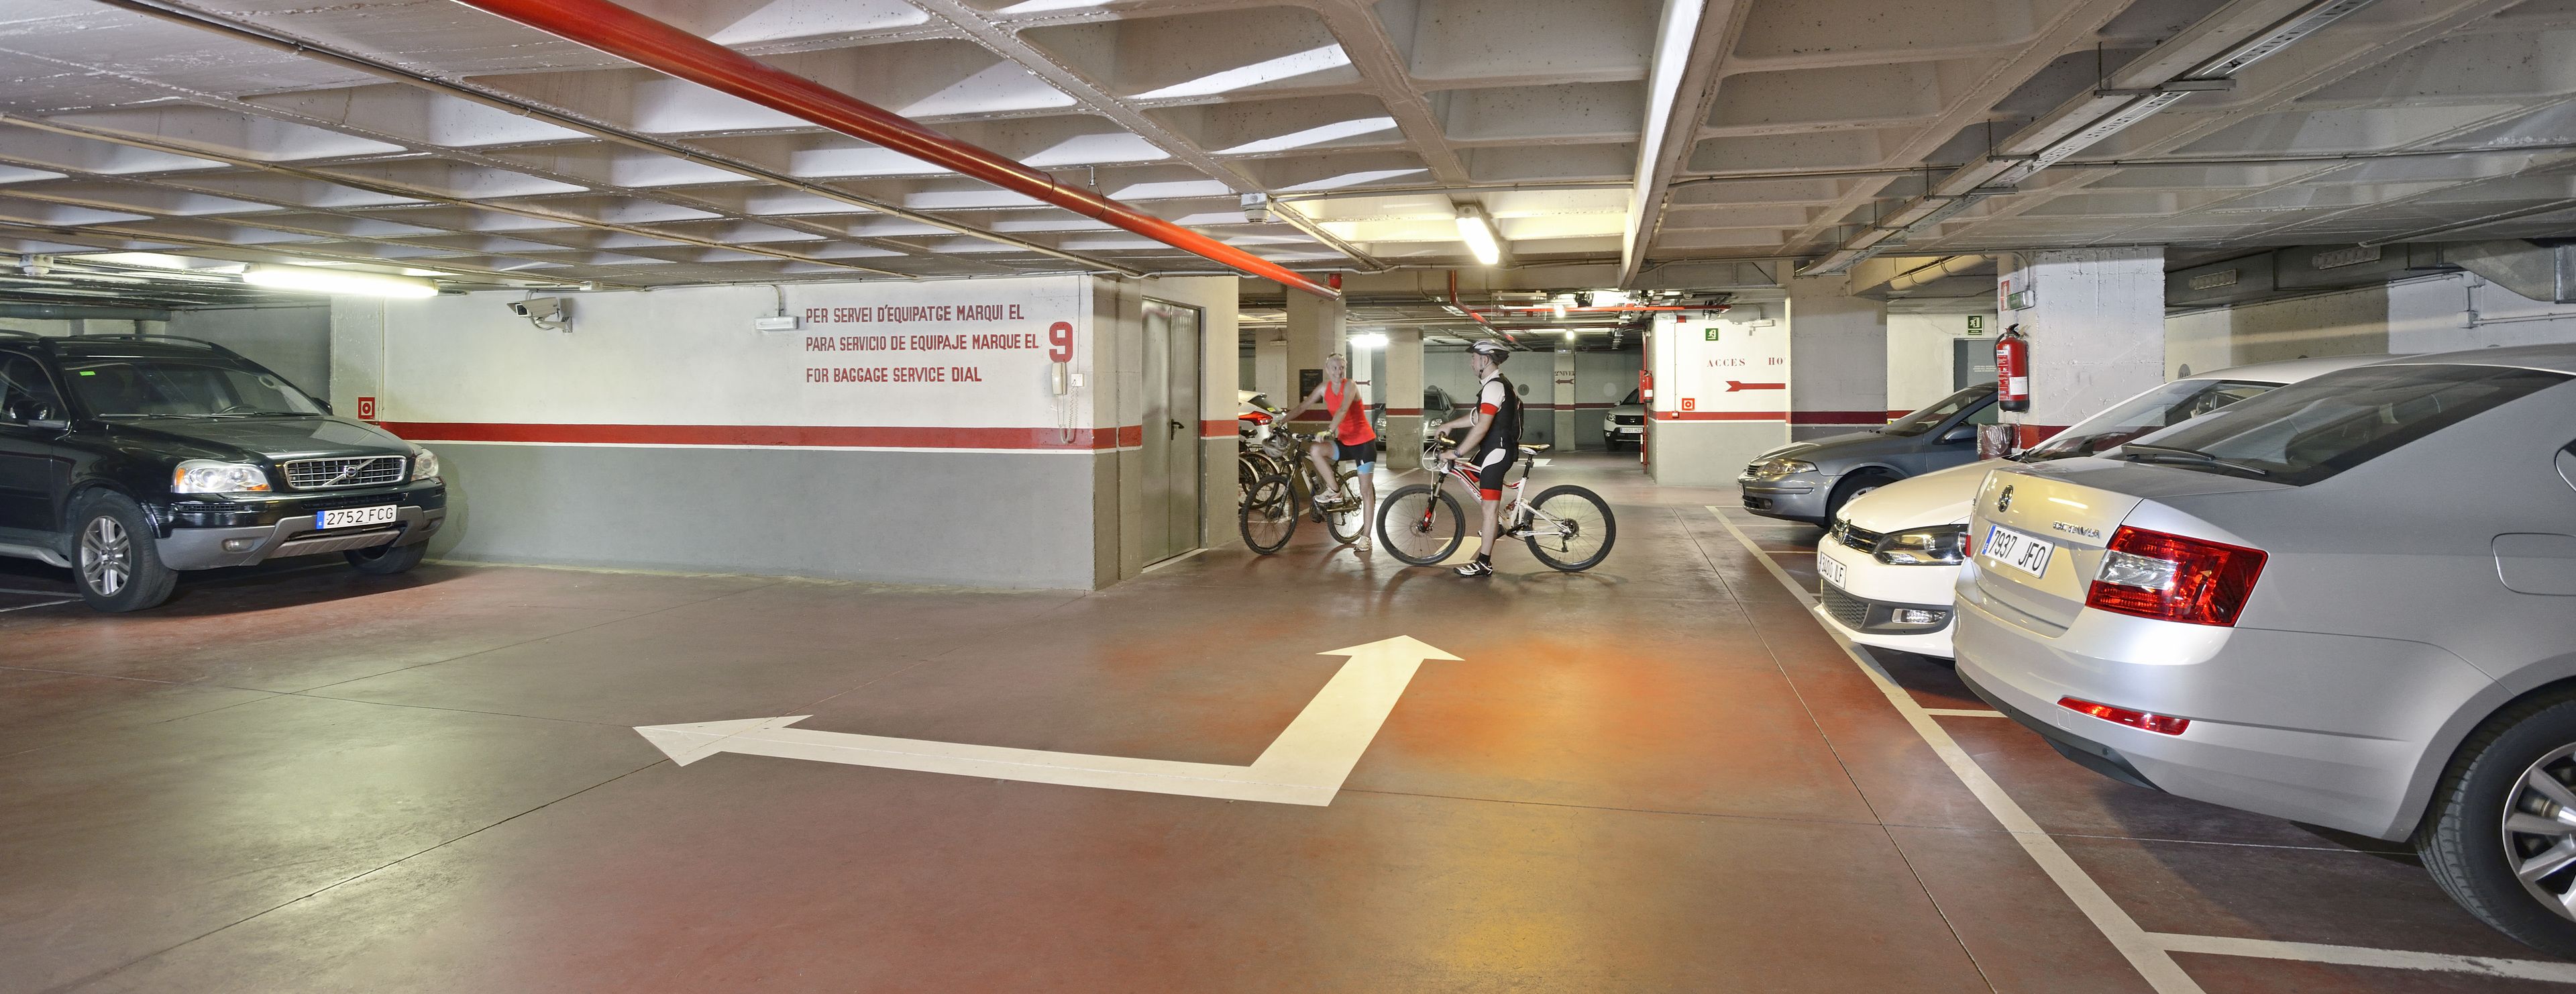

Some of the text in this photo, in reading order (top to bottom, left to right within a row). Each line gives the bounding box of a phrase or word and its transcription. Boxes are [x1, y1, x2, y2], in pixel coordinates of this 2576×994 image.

[806, 304, 1024, 324] PER SERVEI D'EQUIPATGE MARQUI EL
[806, 334, 1039, 352] PARA SERVICIO DE EQUIPAJE MARQUE EL
[1049, 321, 1074, 363] 9
[1707, 356, 1786, 367] ACCES HO
[807, 366, 982, 383] FOR BAGGAGE SERVICE DIAL
[327, 507, 393, 526] 2752 FCG
[2052, 521, 2100, 539] OCTAVIA
[1988, 530, 2018, 559] 7937
[2018, 542, 2046, 571] JFO
